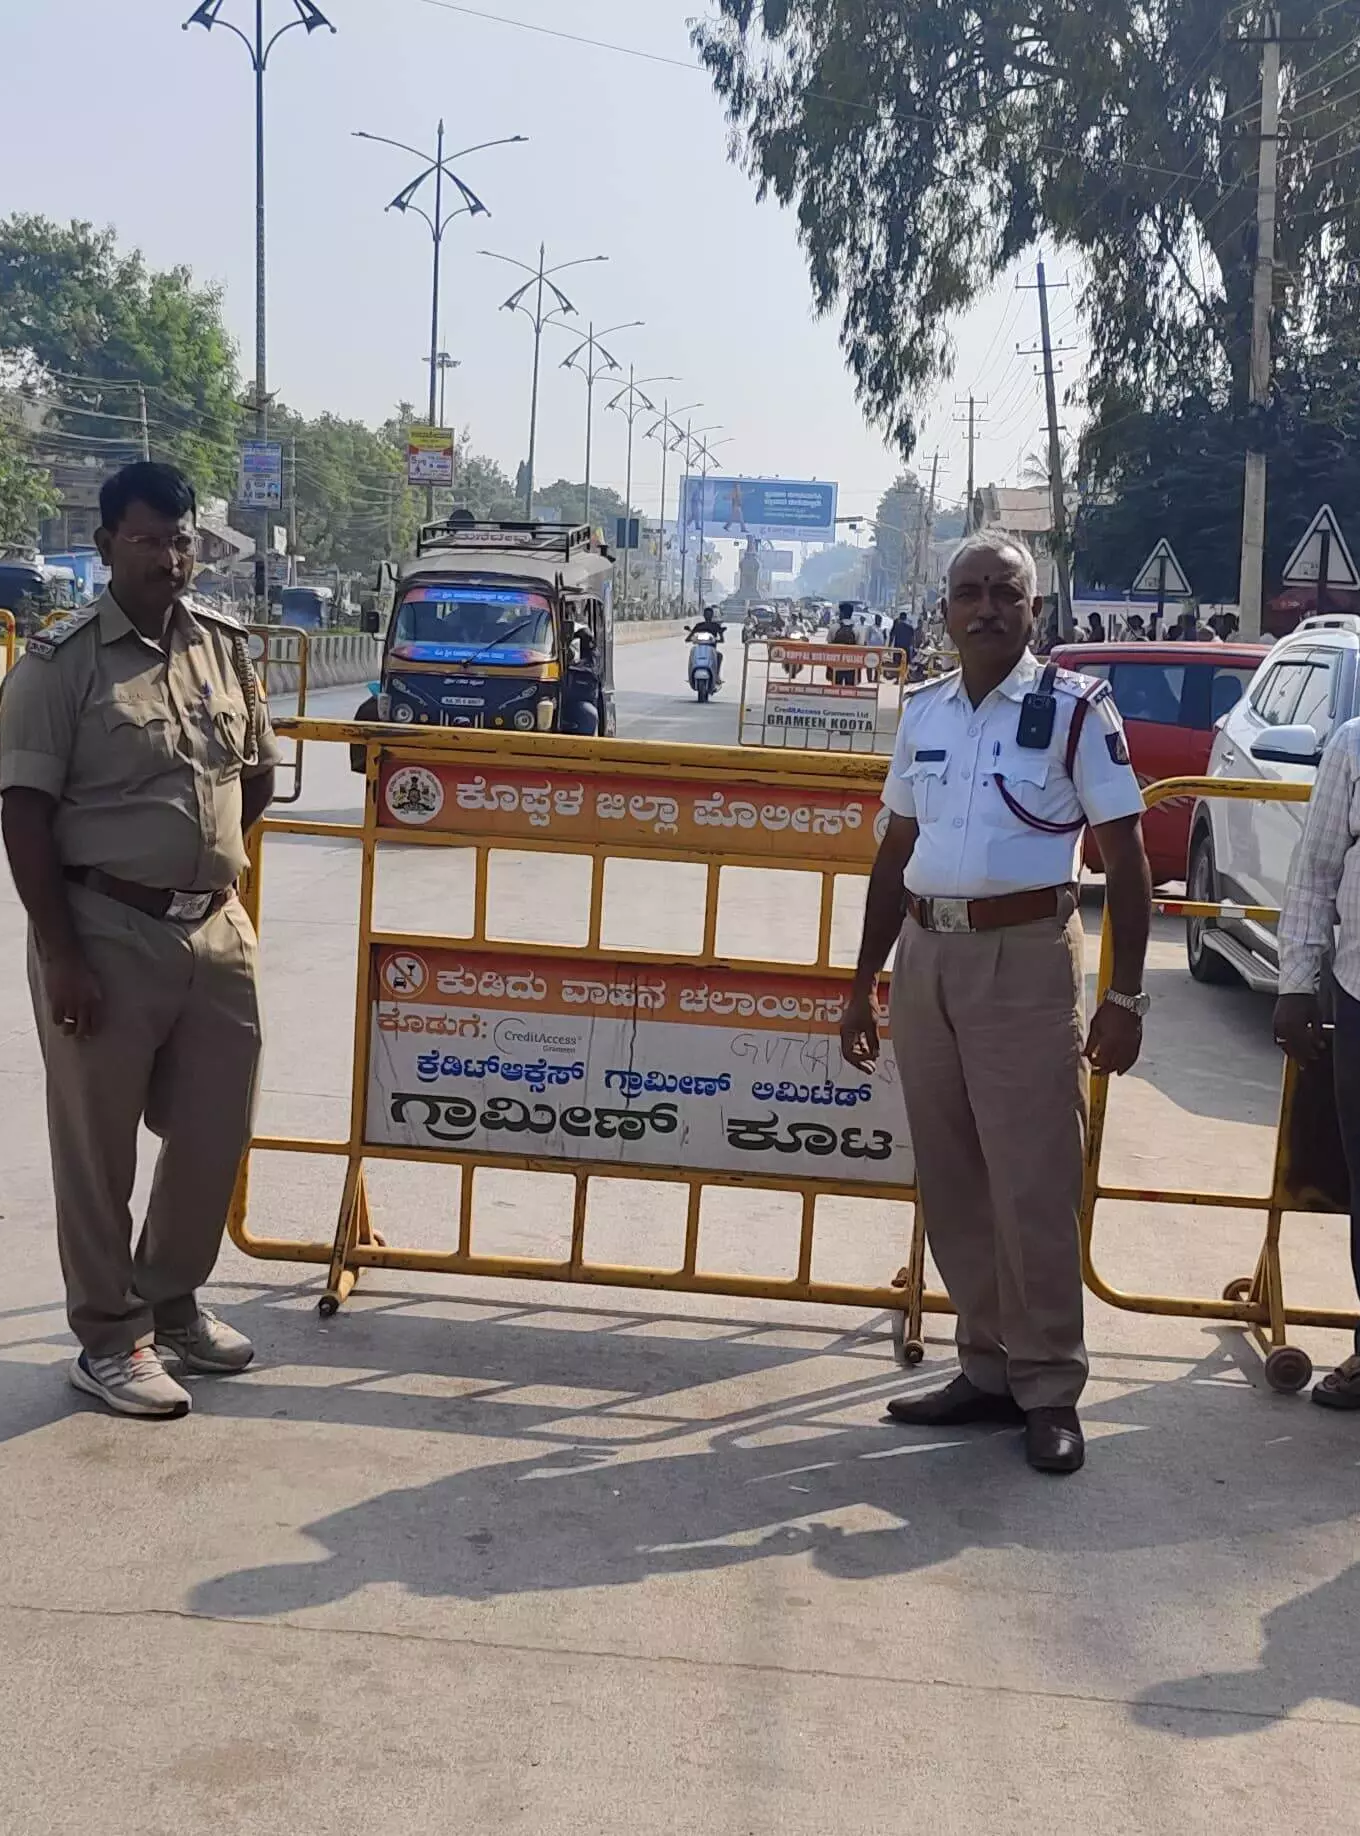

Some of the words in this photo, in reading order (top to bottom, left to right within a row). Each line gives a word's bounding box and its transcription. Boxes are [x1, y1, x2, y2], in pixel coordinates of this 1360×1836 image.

[767, 714, 826, 729] GRAMEEN
[830, 718, 873, 731] KOOTA
[455, 776, 584, 826] ಕೊಪ್ಪಳ
[596, 791, 678, 836] ಜಿಲ್ಲಾ
[693, 791, 863, 835] ಪೊಲೀಸ್
[436, 964, 547, 1000] ಕುಡಿದು
[562, 979, 666, 1010] ವಾಹನ
[542, 1045, 576, 1054] Grameen
[605, 1069, 731, 1099] ಗ್ರಾಮೀಣ್
[751, 1079, 872, 1107] ಲಿಮಿಟೆಡ್
[391, 1092, 679, 1141] ಗ್ರಾಮೀಣ್
[726, 1109, 893, 1160] ಕೂಟ
